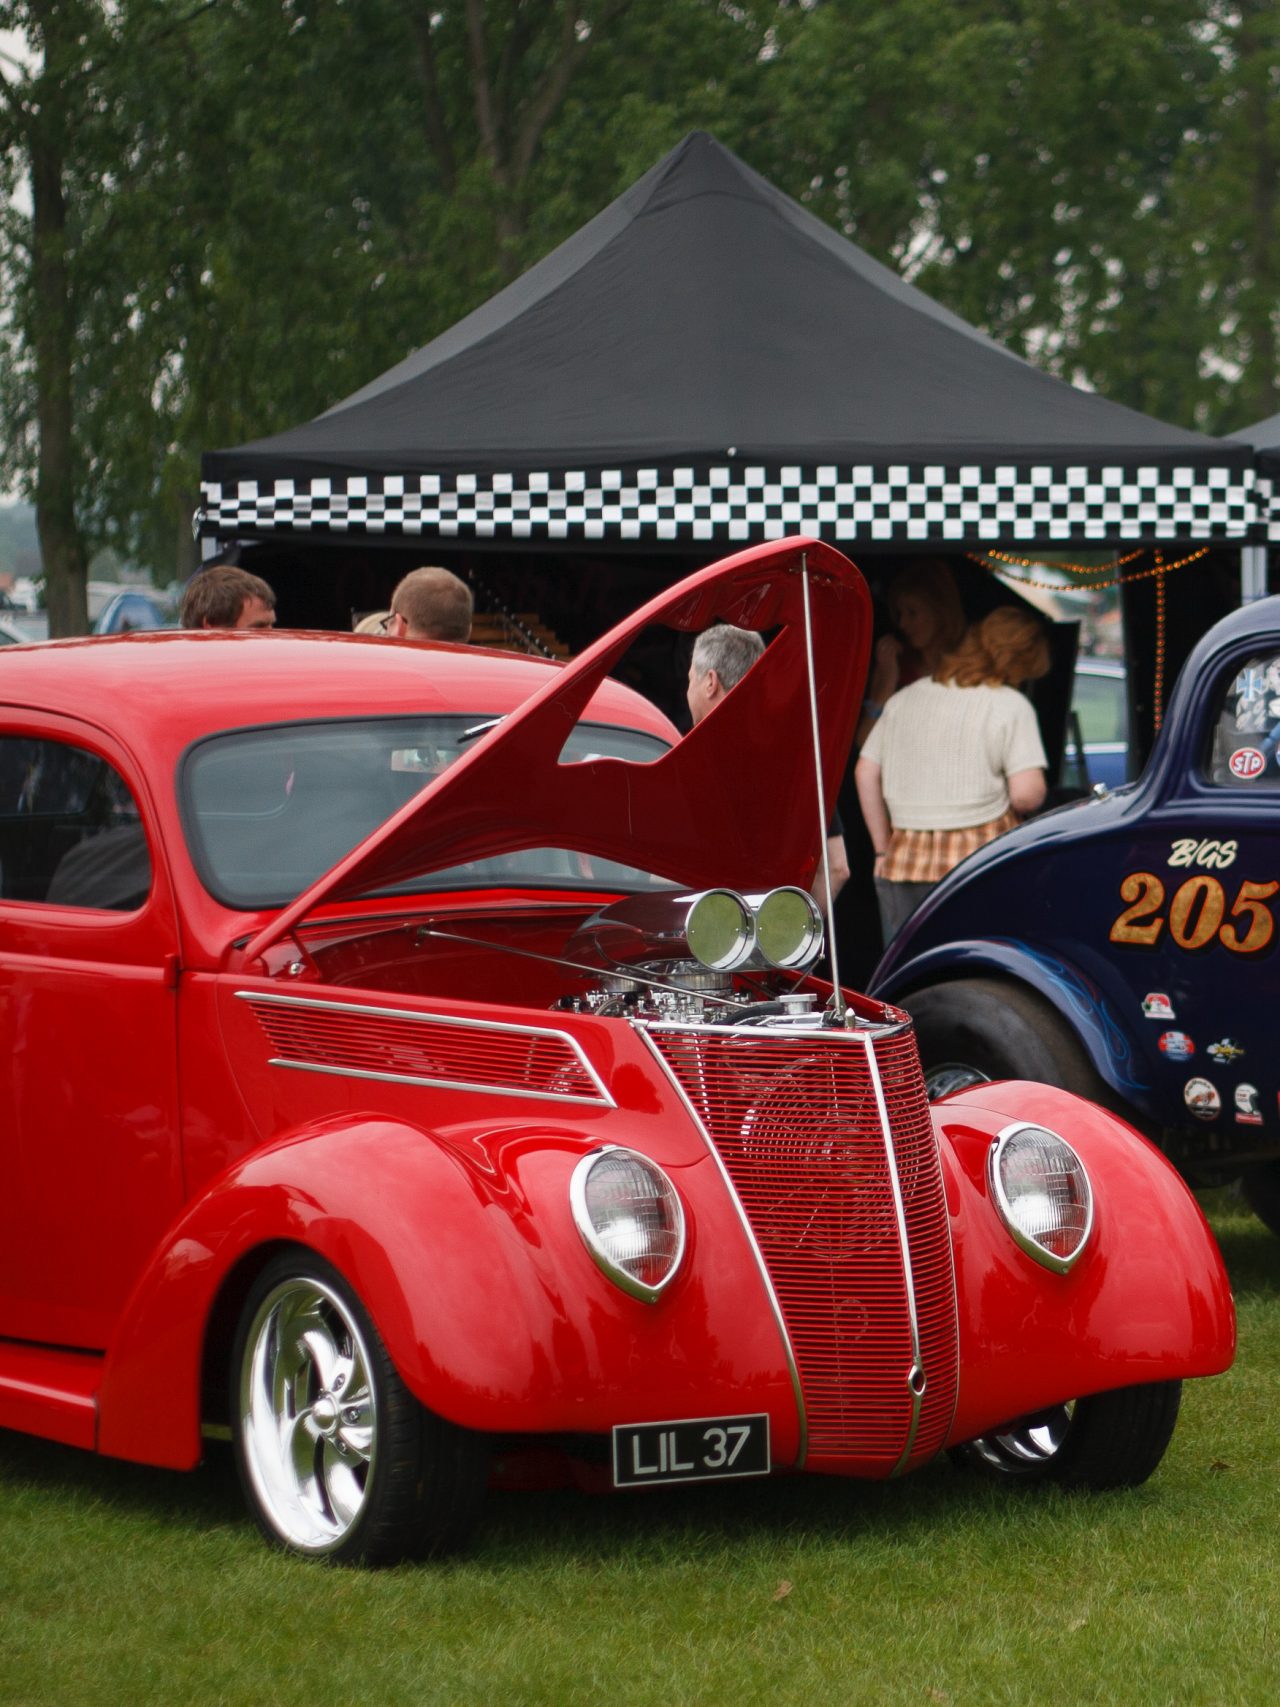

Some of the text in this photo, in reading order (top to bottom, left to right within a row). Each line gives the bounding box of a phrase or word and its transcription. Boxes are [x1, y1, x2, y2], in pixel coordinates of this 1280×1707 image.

[1233, 752, 1261, 776] STP
[1110, 871, 1280, 953] 205
[632, 1425, 751, 1475] LIL 37
